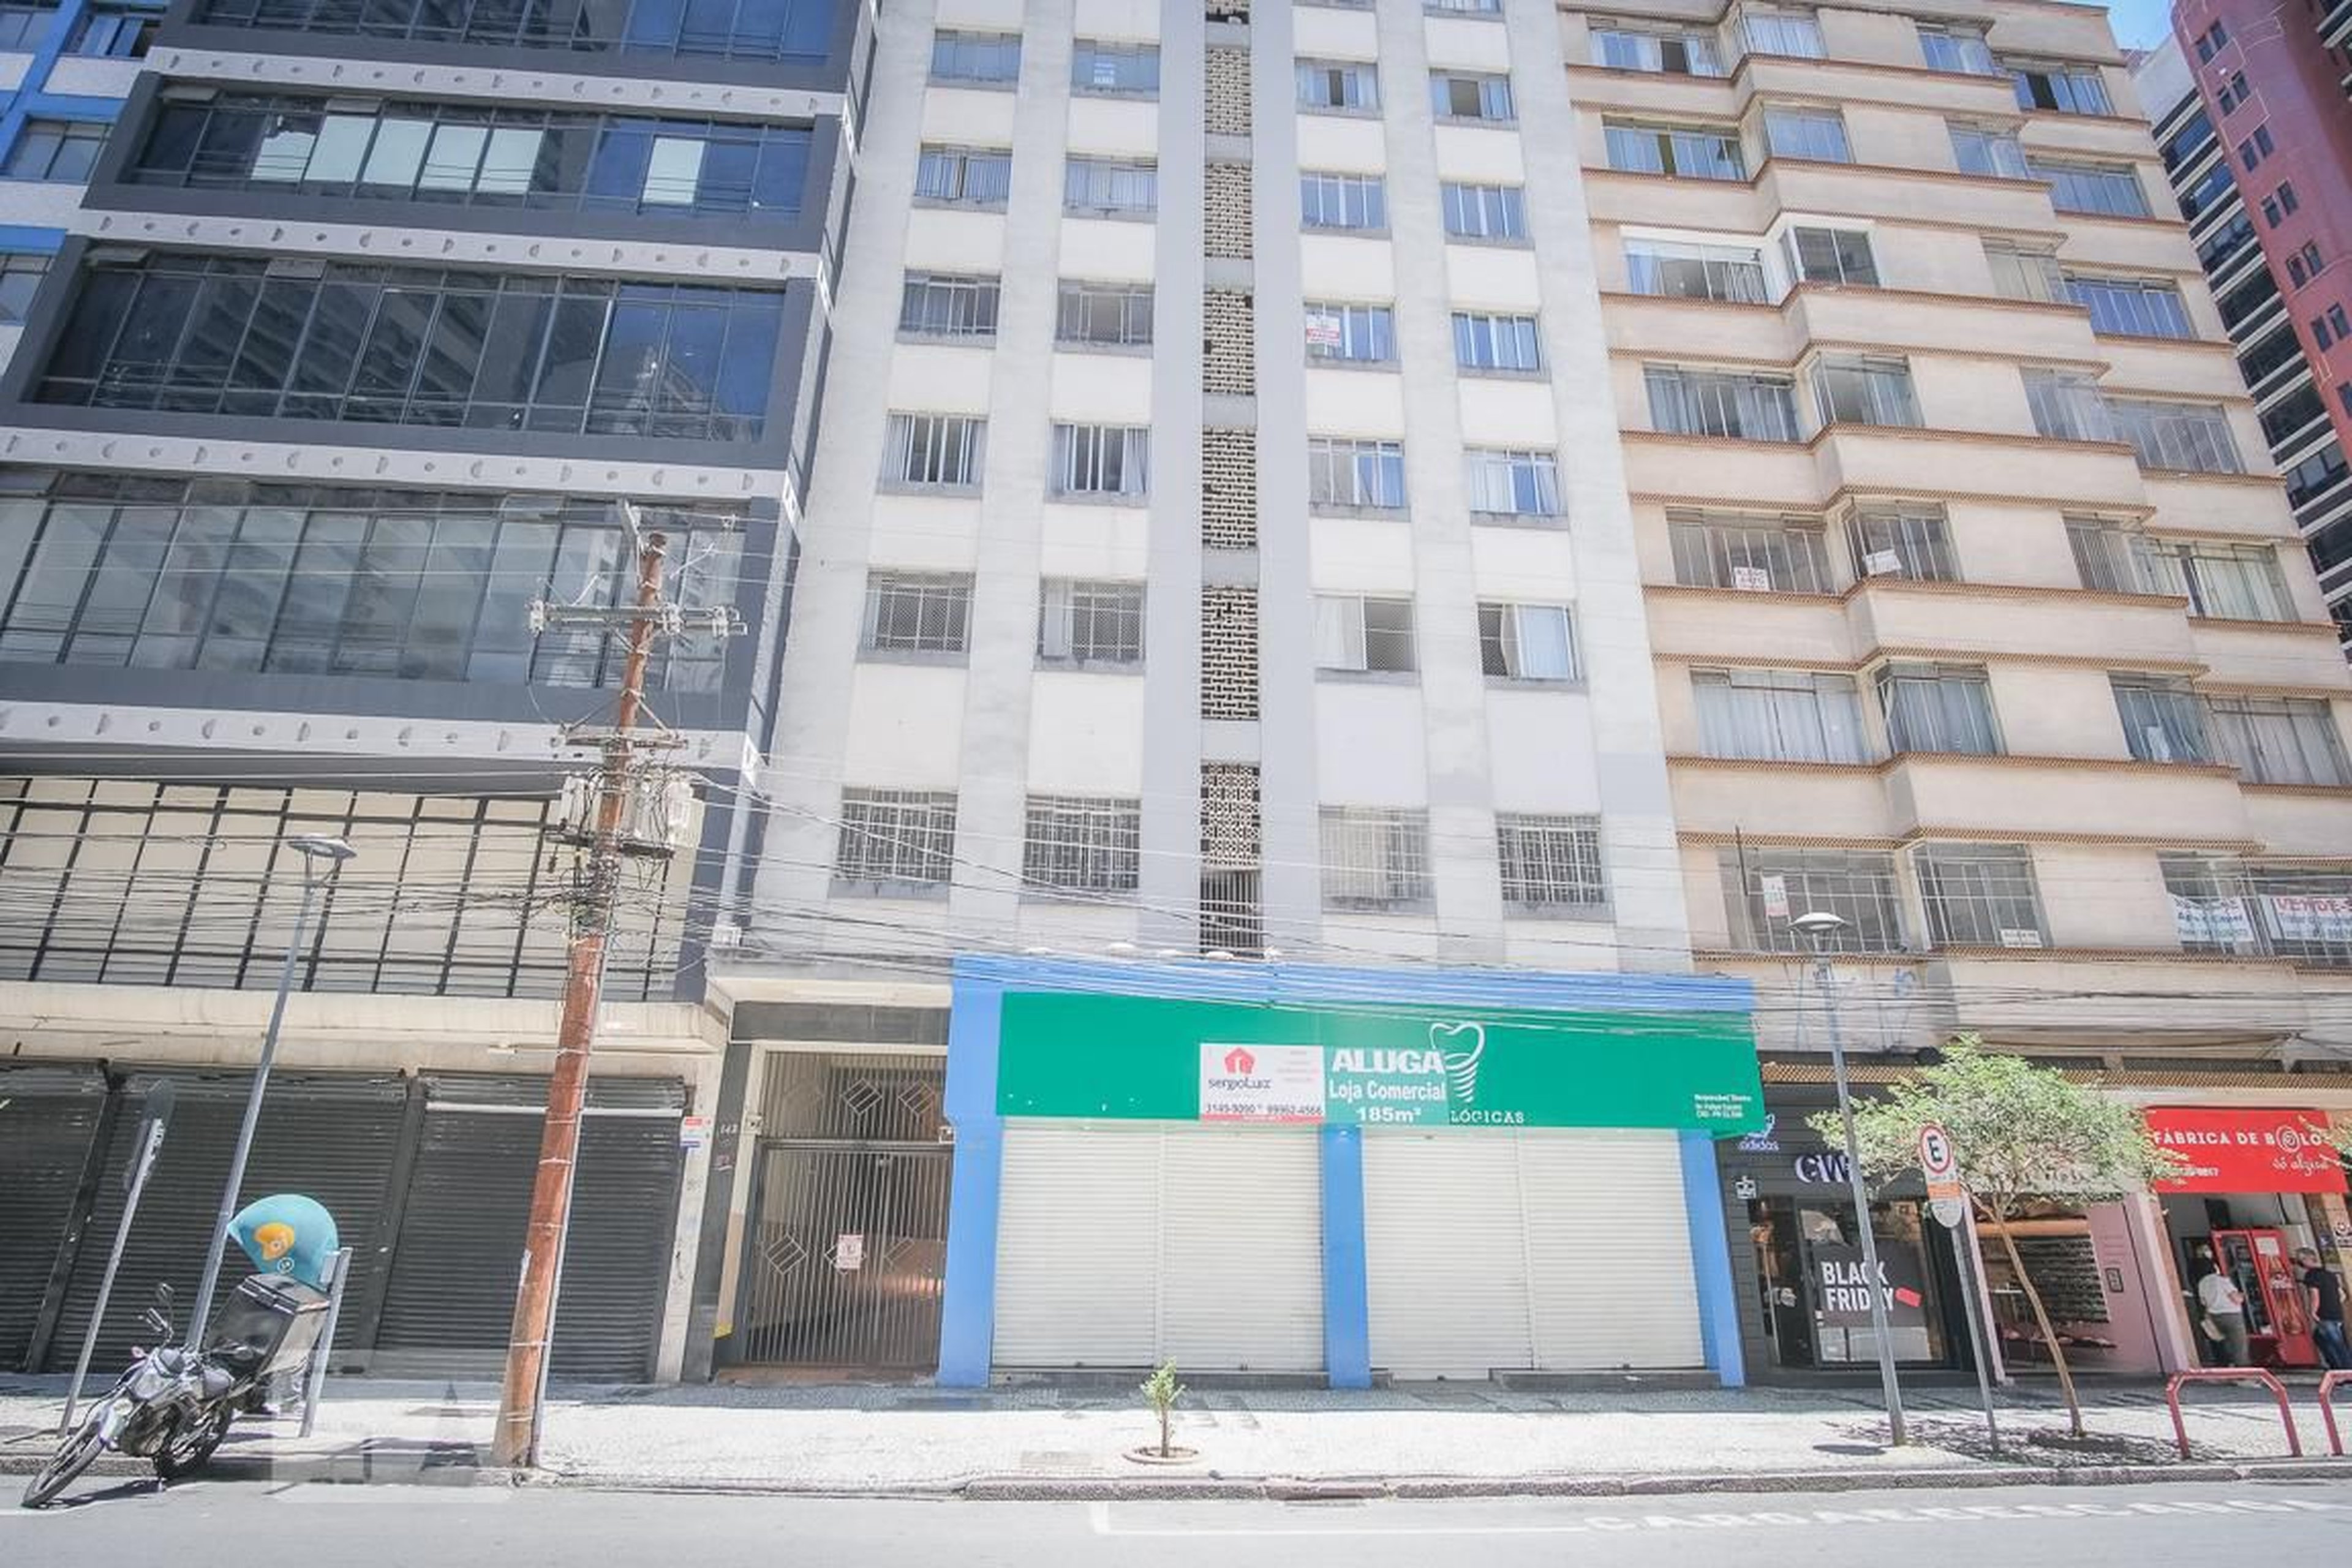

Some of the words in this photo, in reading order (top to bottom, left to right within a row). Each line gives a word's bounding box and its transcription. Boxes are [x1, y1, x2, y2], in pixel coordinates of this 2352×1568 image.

[1332, 1049, 1446, 1074] ALUGA
[1329, 1080, 1363, 1103] Loja
[1367, 1081, 1447, 1101] Comercial
[1738, 1139, 1779, 1151] adidas
[2154, 1128, 2231, 1145] FÁBRICA
[2237, 1132, 2260, 1144] DE
[1927, 1135, 1942, 1162] E
[1825, 1287, 1894, 1311] FRIDY
